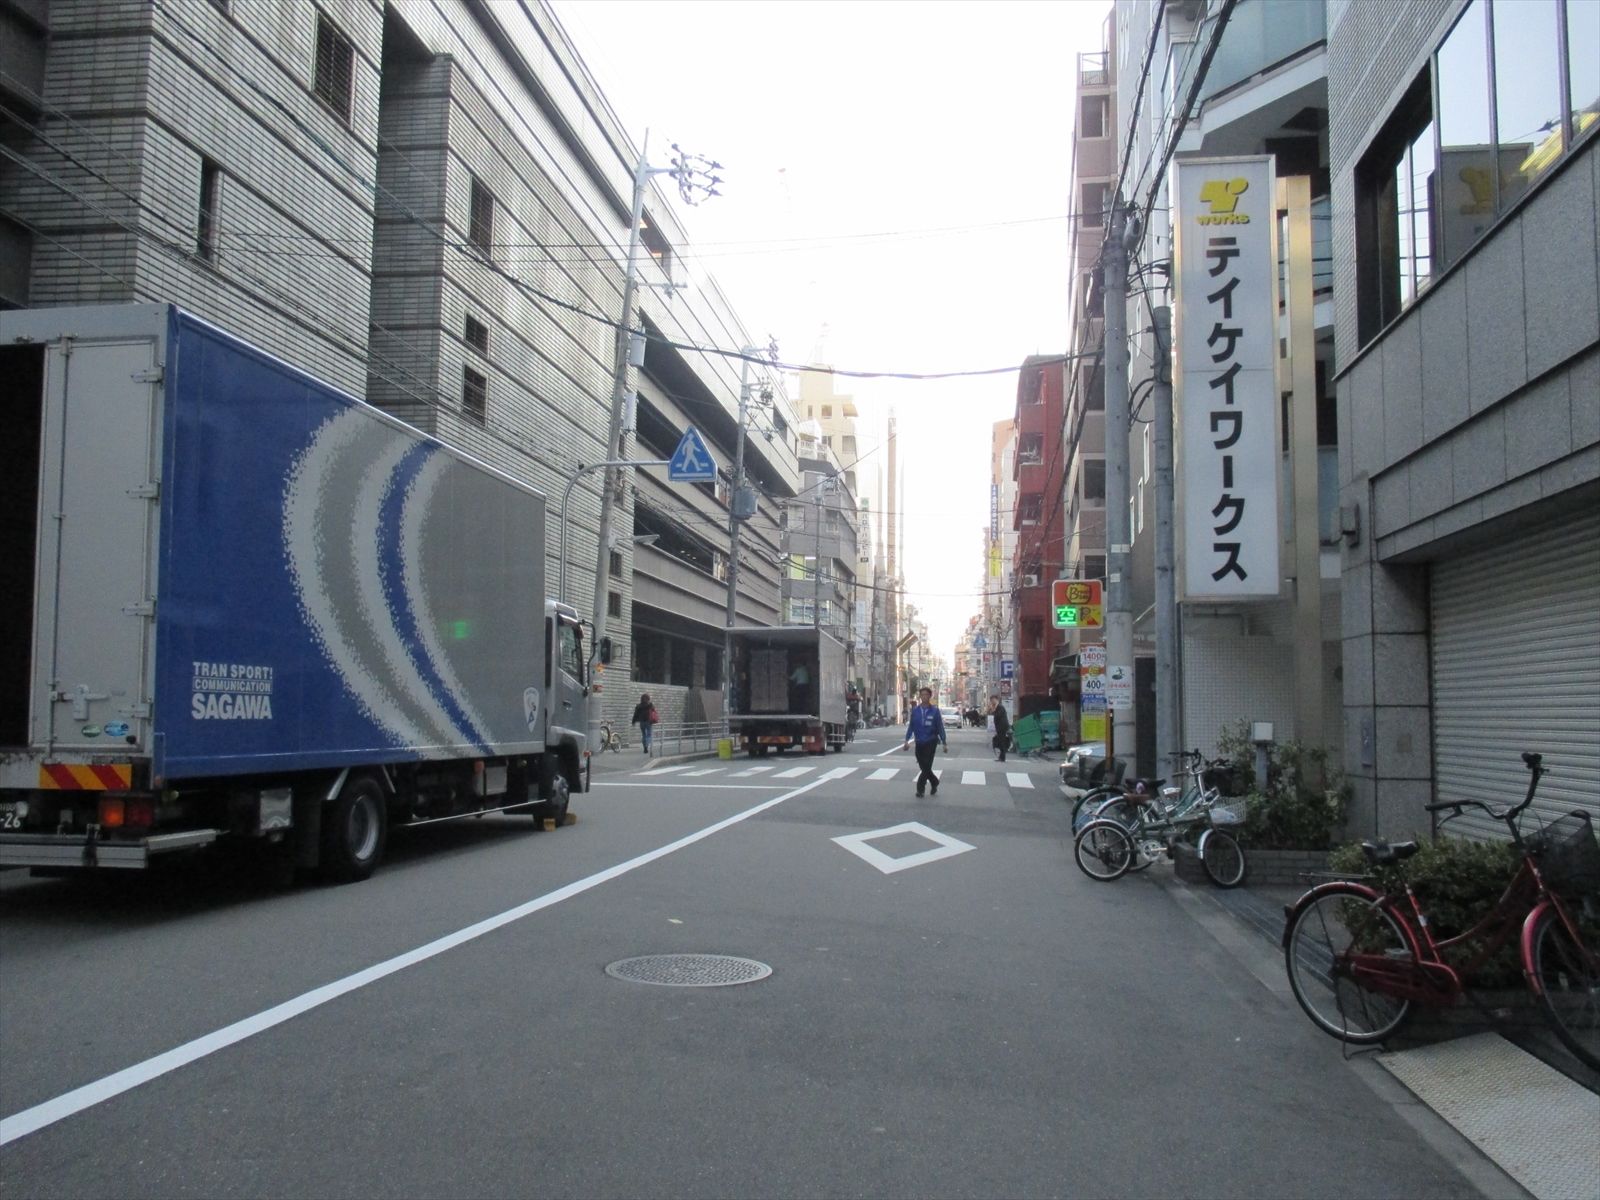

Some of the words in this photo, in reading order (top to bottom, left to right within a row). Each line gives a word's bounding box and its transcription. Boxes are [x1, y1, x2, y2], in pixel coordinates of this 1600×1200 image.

[1205, 236, 1248, 582] テイケイワークス
[1057, 606, 1076, 625] 空
[195, 679, 271, 692] COMMUNICATION
[192, 692, 273, 719] SAGAWA
